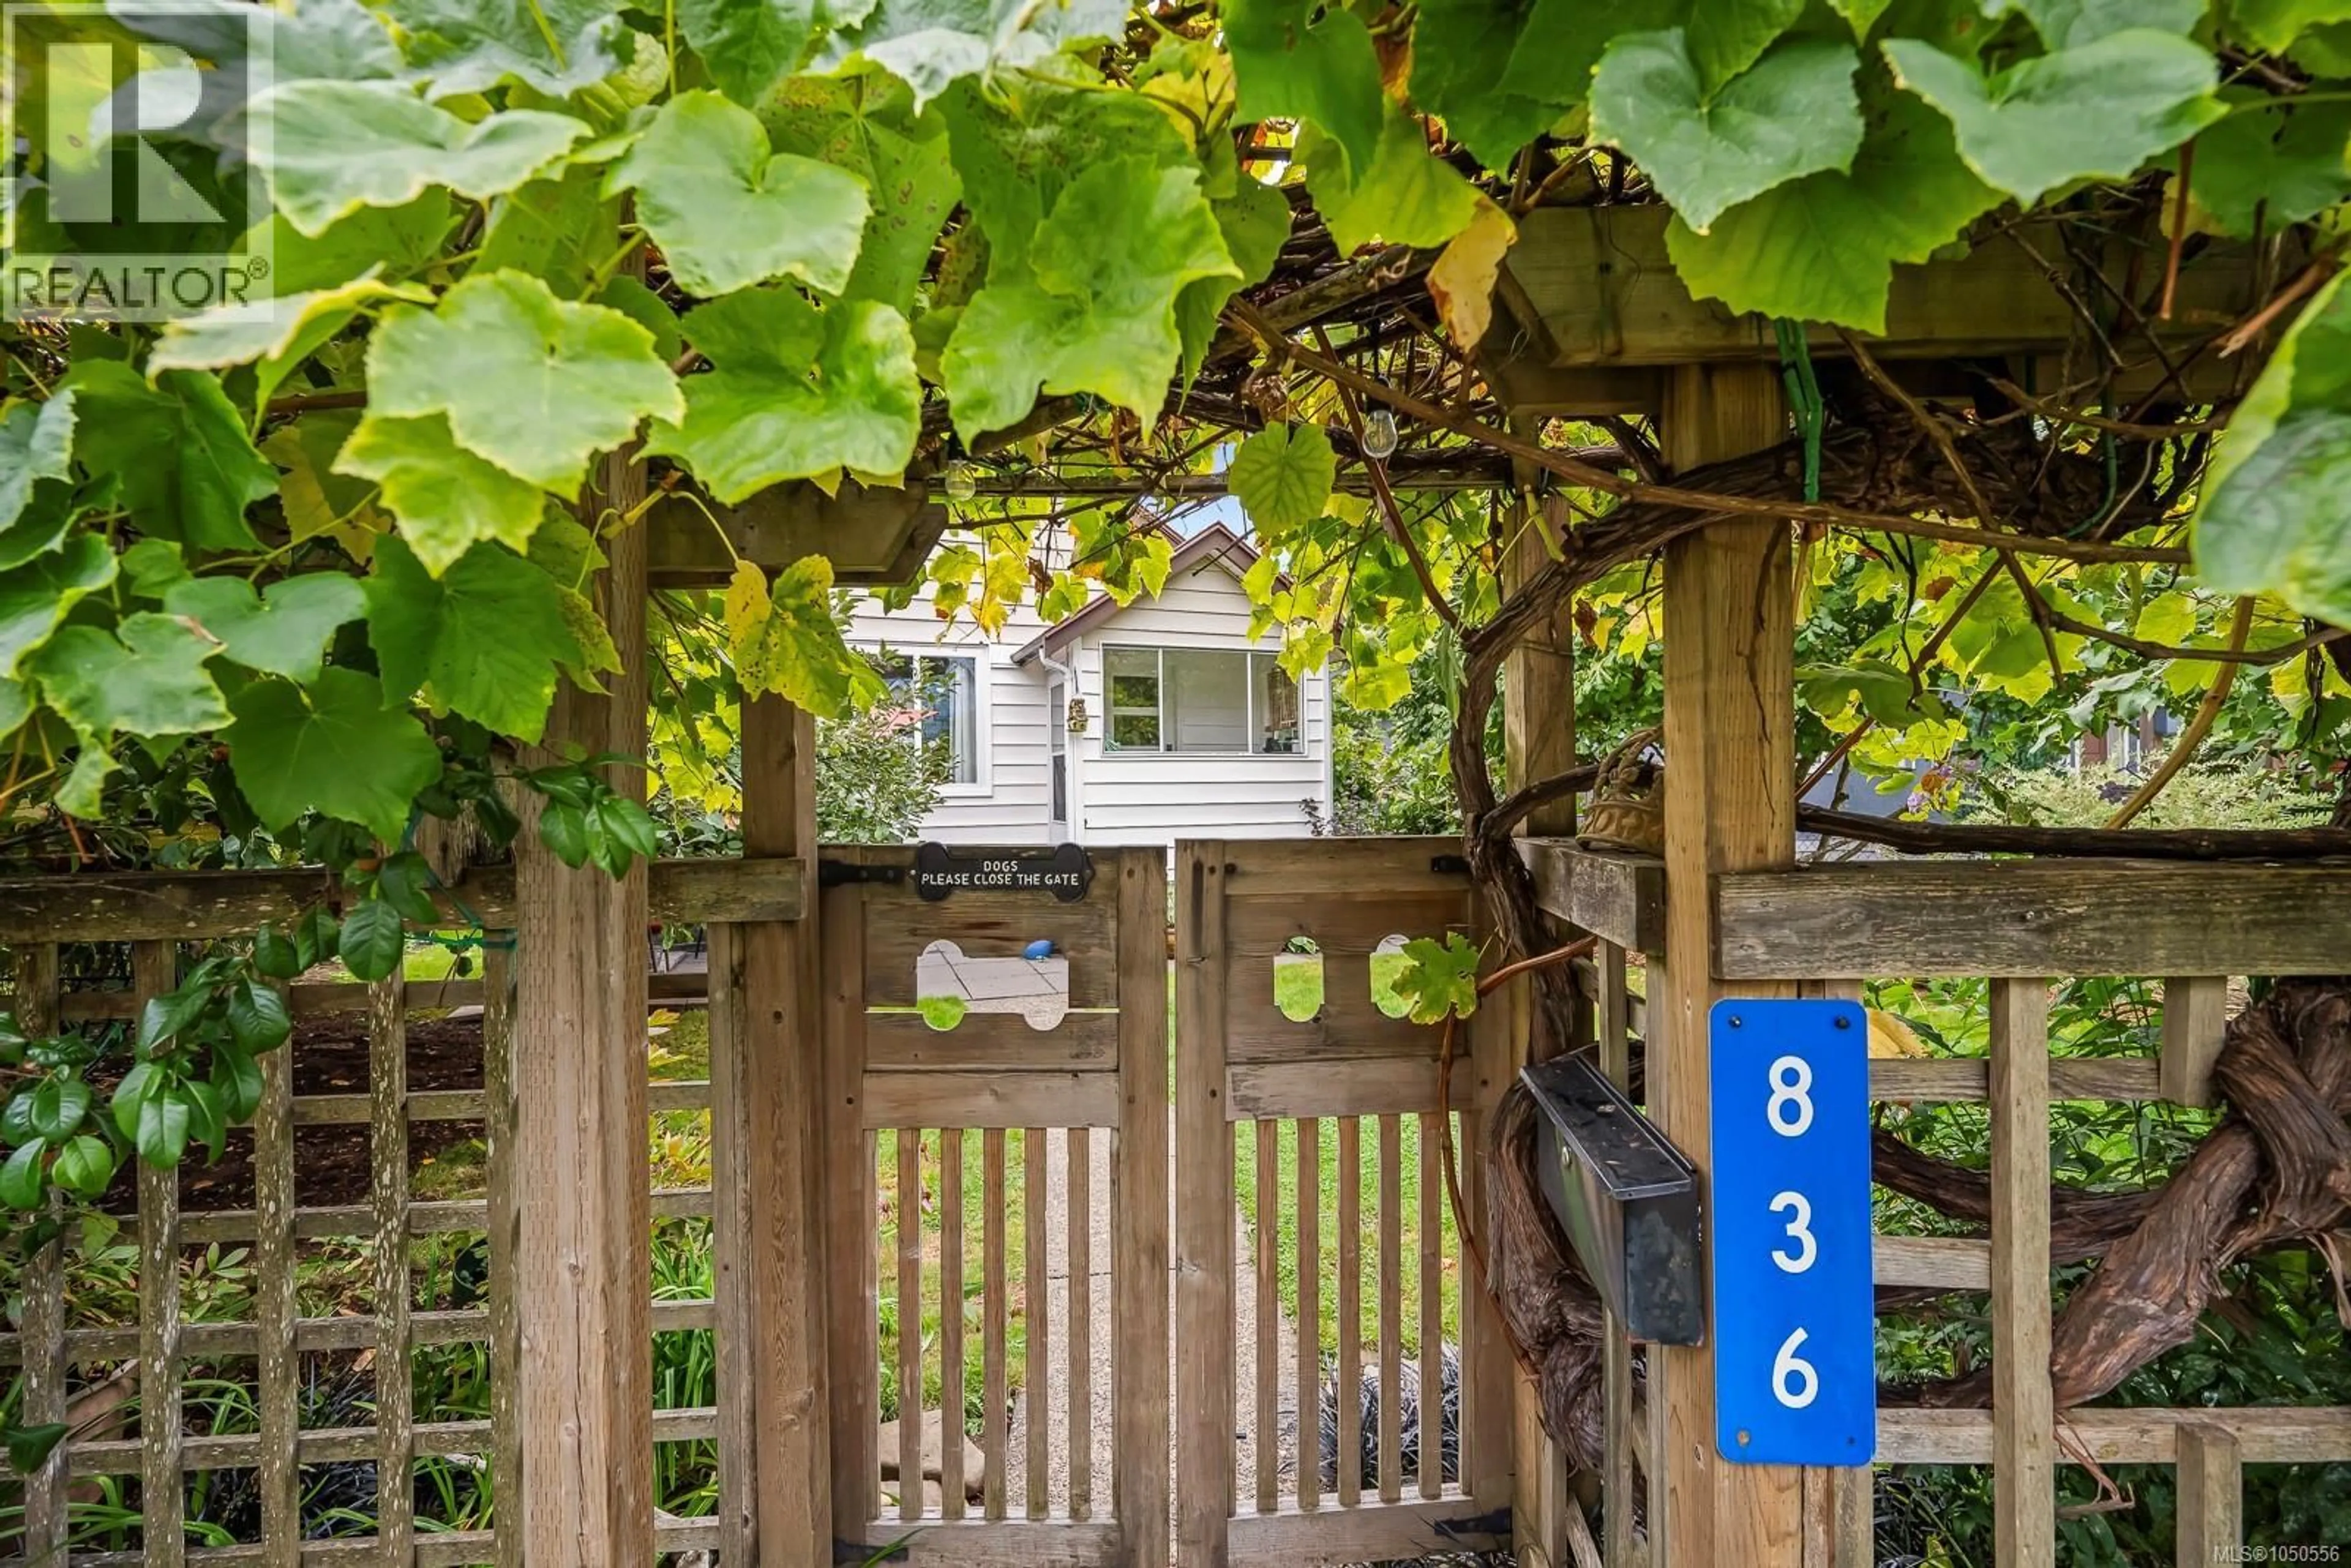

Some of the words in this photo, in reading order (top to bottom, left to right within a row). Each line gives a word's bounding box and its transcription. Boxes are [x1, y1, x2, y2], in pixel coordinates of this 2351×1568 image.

[983, 861, 1018, 872] DOGS
[921, 873, 969, 885] PLEASE
[974, 873, 1012, 885] CLOSE
[1017, 874, 1040, 885] THE
[1044, 874, 1079, 886] GATE
